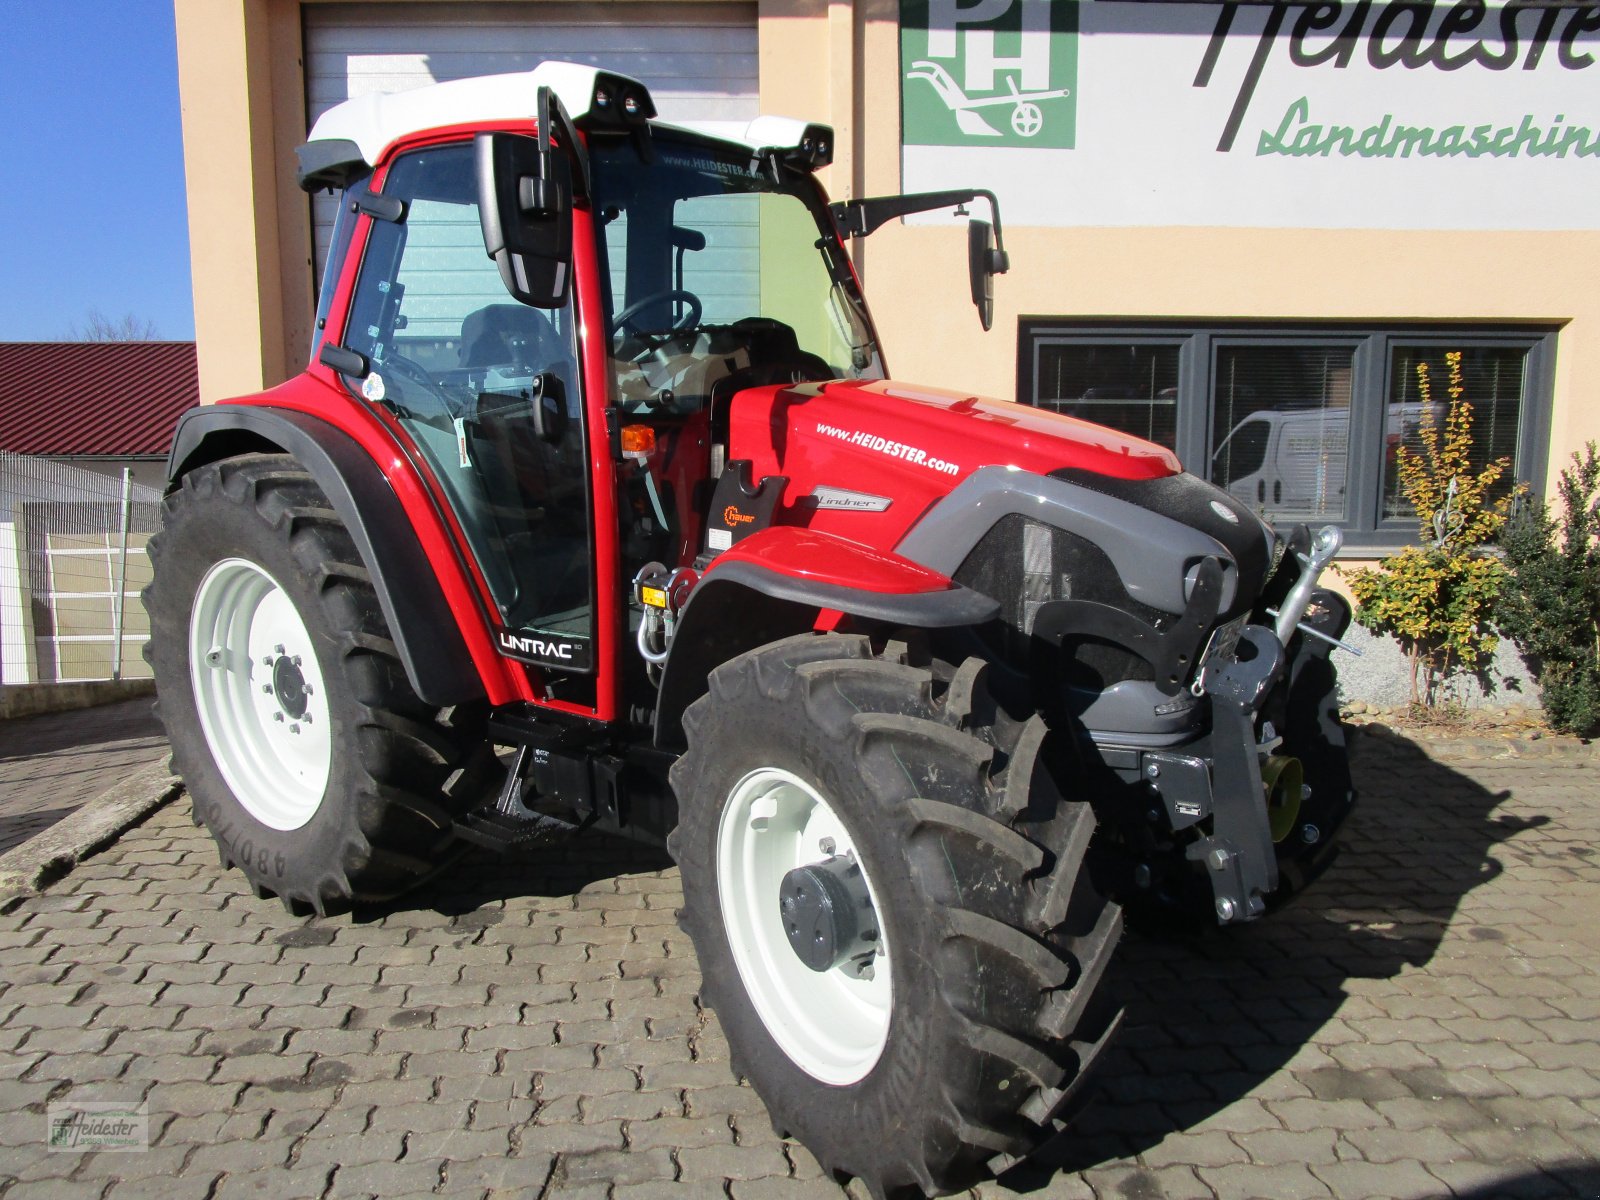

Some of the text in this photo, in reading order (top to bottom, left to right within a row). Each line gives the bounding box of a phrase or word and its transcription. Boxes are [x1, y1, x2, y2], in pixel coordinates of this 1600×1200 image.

[1256, 96, 1600, 158] Landmaschin
[816, 422, 959, 476] www.HEIDESTER.com
[728, 507, 755, 523] hauer
[818, 496, 876, 507] Lindner
[500, 632, 572, 659] LINTRAC
